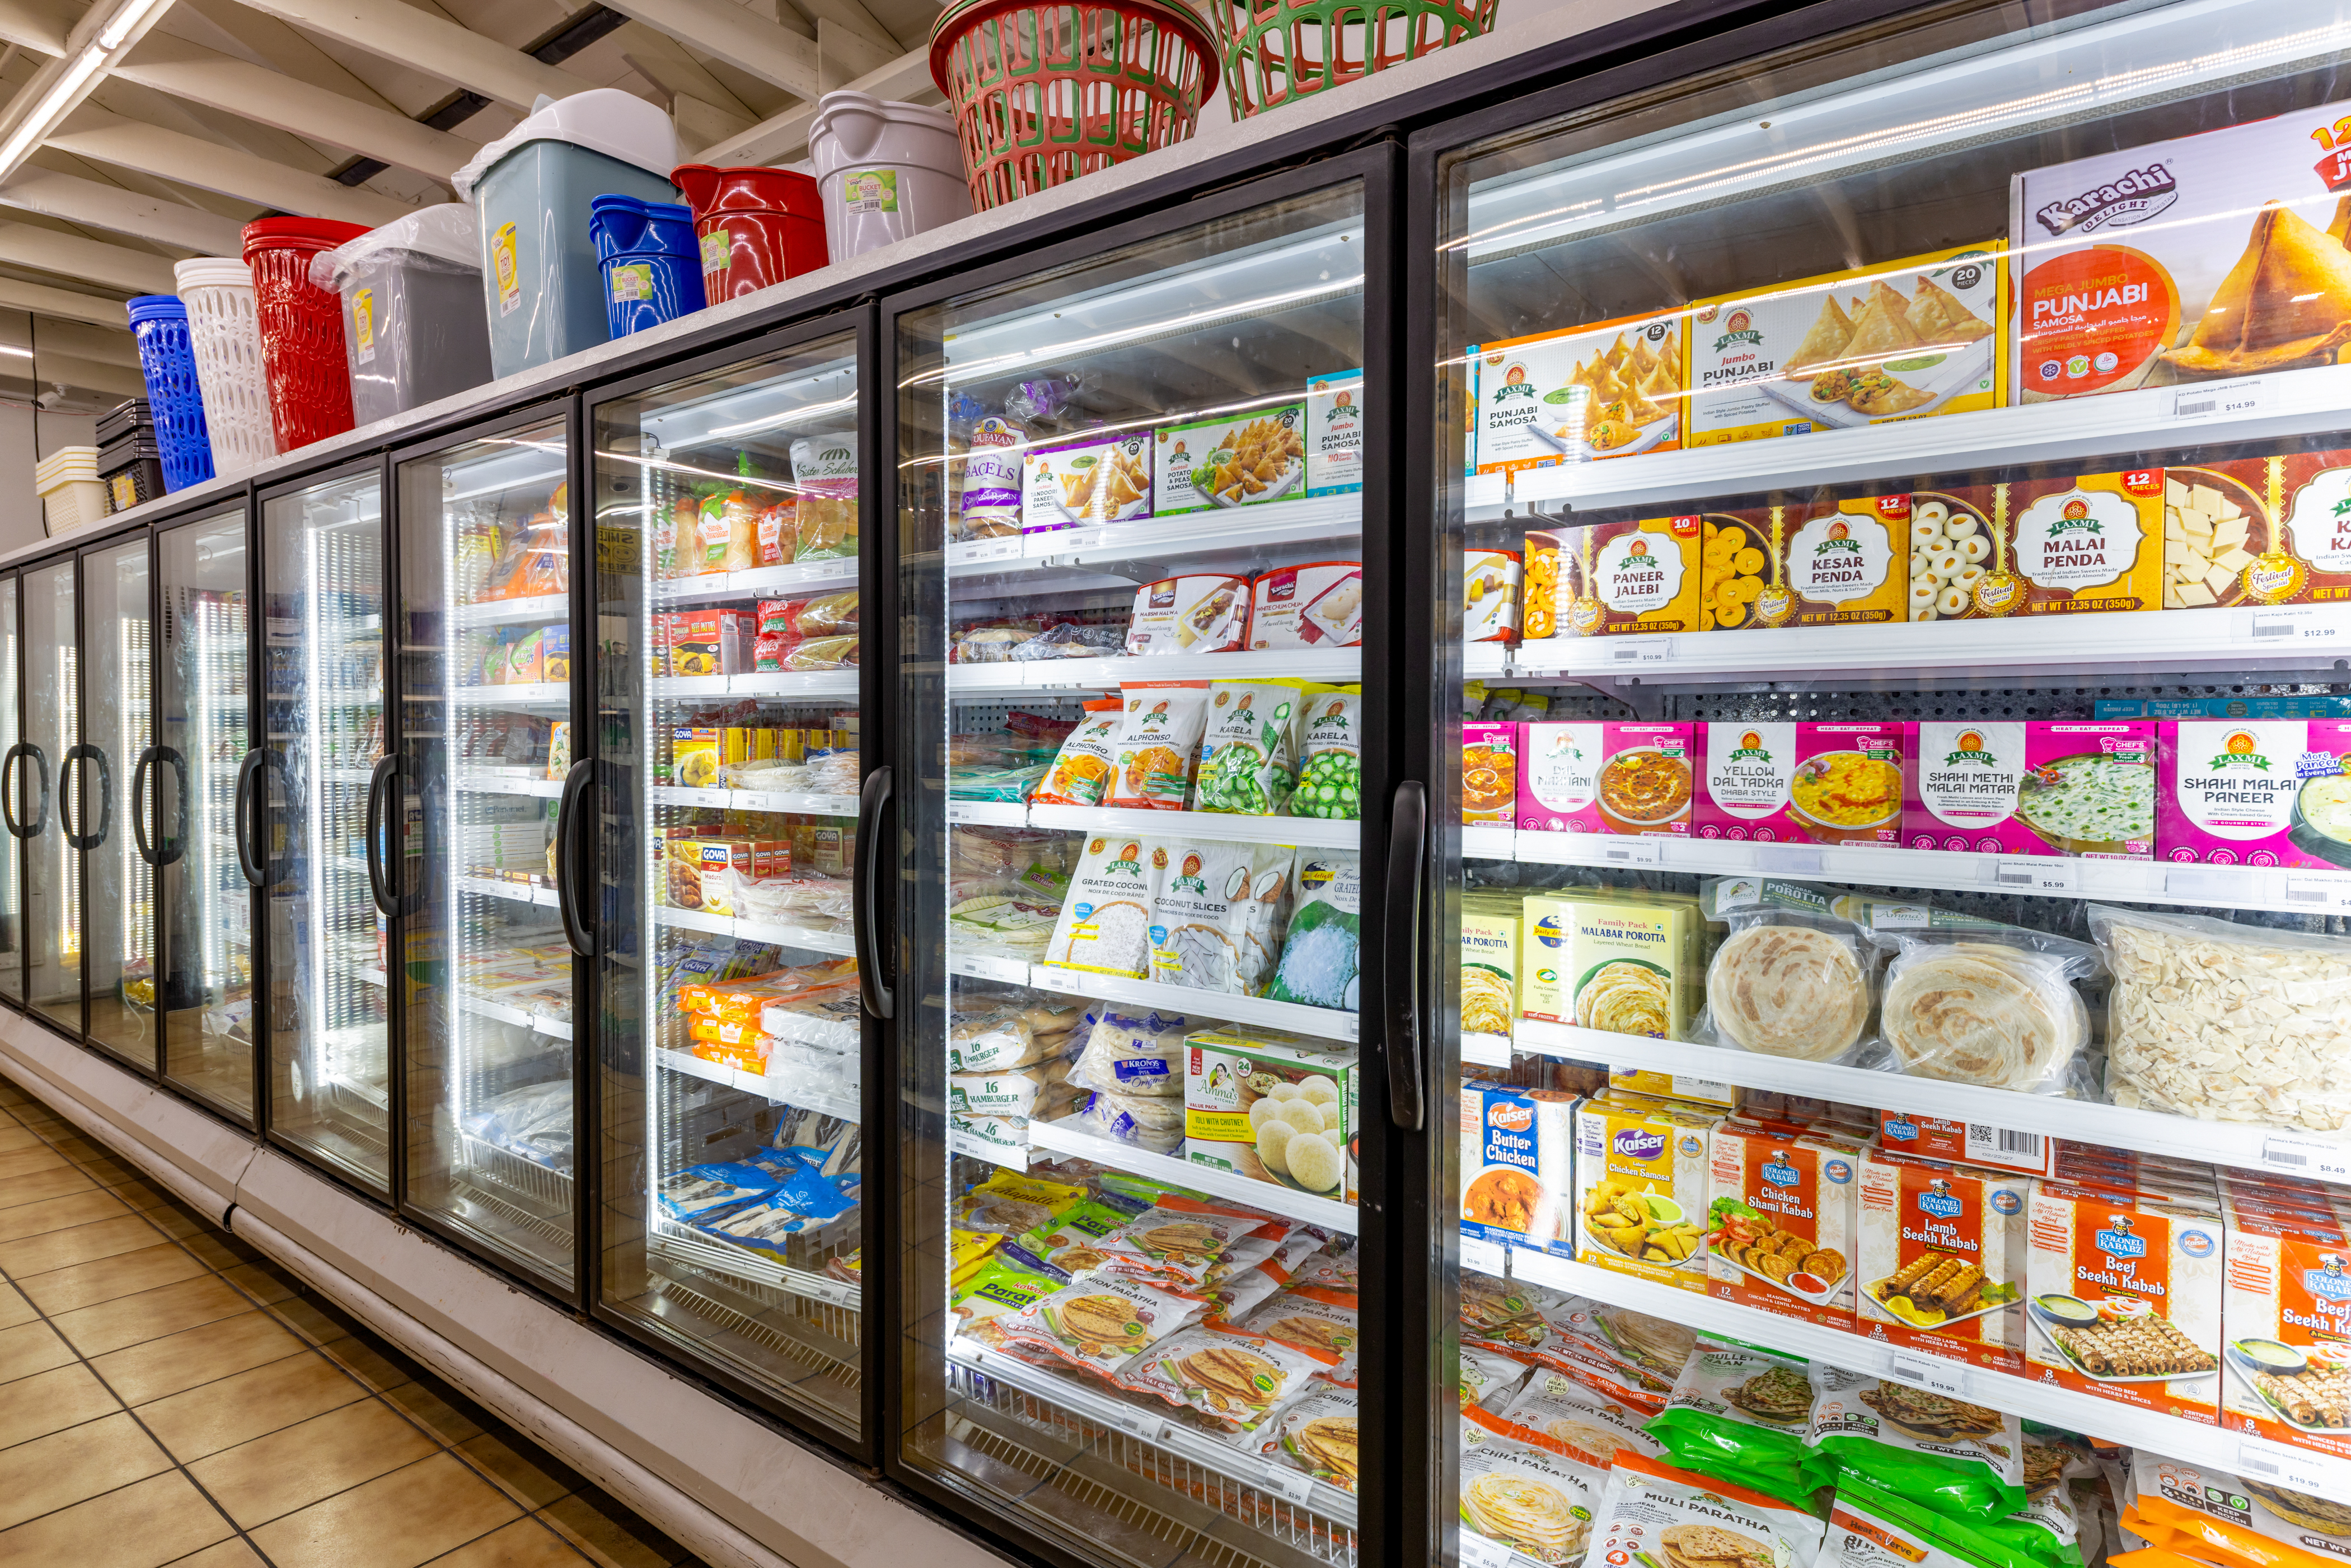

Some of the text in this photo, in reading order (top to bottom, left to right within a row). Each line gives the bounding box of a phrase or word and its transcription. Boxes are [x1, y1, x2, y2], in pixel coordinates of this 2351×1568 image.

[2039, 167, 2173, 227] Karachi
[2085, 200, 2148, 229] DELIGHT
[500, 254, 510, 268] TIDY
[1957, 268, 1976, 280] 20
[2034, 273, 2128, 299] MEGA JUMBO
[2034, 283, 2147, 320] PUNJABI
[2033, 314, 2083, 330] SAMOSA
[1721, 352, 1755, 366] Jumbo
[1703, 361, 1774, 381] PUNJABI
[1331, 407, 1355, 415] LAXMI
[2226, 400, 2255, 412] $14.99
[1490, 407, 1538, 419] PUNJABI
[1331, 422, 1354, 432] Jumbo
[1490, 416, 1537, 428] SAMOSA
[1322, 431, 1361, 443] PUNJABI
[1322, 439, 1361, 450] SAMOSA
[1328, 453, 1338, 462] NO
[798, 464, 821, 478] Sister
[966, 461, 1015, 480] BAGELS
[706, 525, 723, 533] King's
[1674, 518, 1690, 528] 10
[705, 530, 728, 540] Hawaiian
[1821, 540, 1857, 549] LAXMI
[2044, 537, 2105, 553] MALAI
[1813, 557, 1864, 570] KESAR
[2044, 554, 2106, 568] PENDA
[1614, 571, 1664, 584] PANEER
[1812, 571, 1863, 583] PENDA
[1614, 584, 1659, 598] JALEBI
[1760, 595, 1788, 610] Festival
[1767, 605, 1786, 615] Special
[691, 621, 715, 632] BEEF PATTIES
[1632, 622, 1648, 631] 12.35
[1659, 621, 1679, 631] (350g)
[675, 730, 691, 740] GOYA
[1220, 727, 1252, 735] KARELA
[2217, 755, 2263, 764] LAXMI
[2301, 751, 2331, 761] More
[2296, 759, 2340, 771] Paneer
[1724, 766, 1774, 777] YELLOW
[2304, 769, 2323, 778] Every
[1713, 777, 1783, 788] DAL TADKA
[1929, 773, 2013, 783] SHAHI METHI
[1927, 784, 2015, 794] MALAI MATAR
[2184, 779, 2297, 790] SHAHI MALAI
[2205, 792, 2274, 803] PANEER
[703, 849, 726, 861] GOYA
[1032, 874, 1055, 888] TOUFAYAN
[1082, 879, 1114, 887] GRATED
[1767, 883, 1826, 905] POROTTA
[1782, 883, 1812, 893] MALABAR
[1154, 897, 1226, 912] COCONUT SLICES
[1598, 919, 1626, 929] Family
[1581, 926, 1665, 943] MALABAR POROTTA
[684, 962, 710, 972] GOYA
[1238, 1061, 1250, 1071] 24
[1132, 1073, 1170, 1088] Original
[985, 1082, 997, 1093] 16
[1197, 1079, 1238, 1101] Amma's
[970, 1094, 1018, 1103] HAMBURGER
[1196, 1116, 1243, 1126] IDLI WITH CHUTNEY
[1488, 1107, 1533, 1126] Kaiser
[1492, 1131, 1531, 1150] Butter
[1614, 1134, 1665, 1156] Kaiser
[1486, 1145, 1535, 1167] Chicken
[1609, 1164, 1670, 1182] Chicken Samosa
[1765, 1167, 1797, 1178] COLONEL
[2320, 1164, 2345, 1173] $8.49
[1765, 1173, 1797, 1183] KABABZ
[991, 1186, 1060, 1205] Chapatti
[1762, 1187, 1800, 1204] Chicken
[1749, 1196, 1813, 1219] Shami Kabab
[1925, 1219, 1956, 1235] Lamb
[1903, 1227, 1978, 1251] Seekh Kabab
[2106, 1256, 2135, 1276] Beef
[2077, 1266, 2165, 1295] Seekh Kabab
[1013, 1281, 1048, 1296] kawan
[1827, 1319, 1851, 1328] HAND-CUT
[1828, 1316, 1851, 1324] CERTIFIED
[1256, 1376, 1272, 1388] EXTRA
[1931, 1382, 1955, 1392] $19.99
[1543, 1395, 1660, 1448] LACHHA PARATHA
[1645, 1492, 1771, 1534] MULI PARATHA
[1850, 1520, 1912, 1556] Heat 'n Serve
[1482, 1558, 1497, 1568] $5.99
